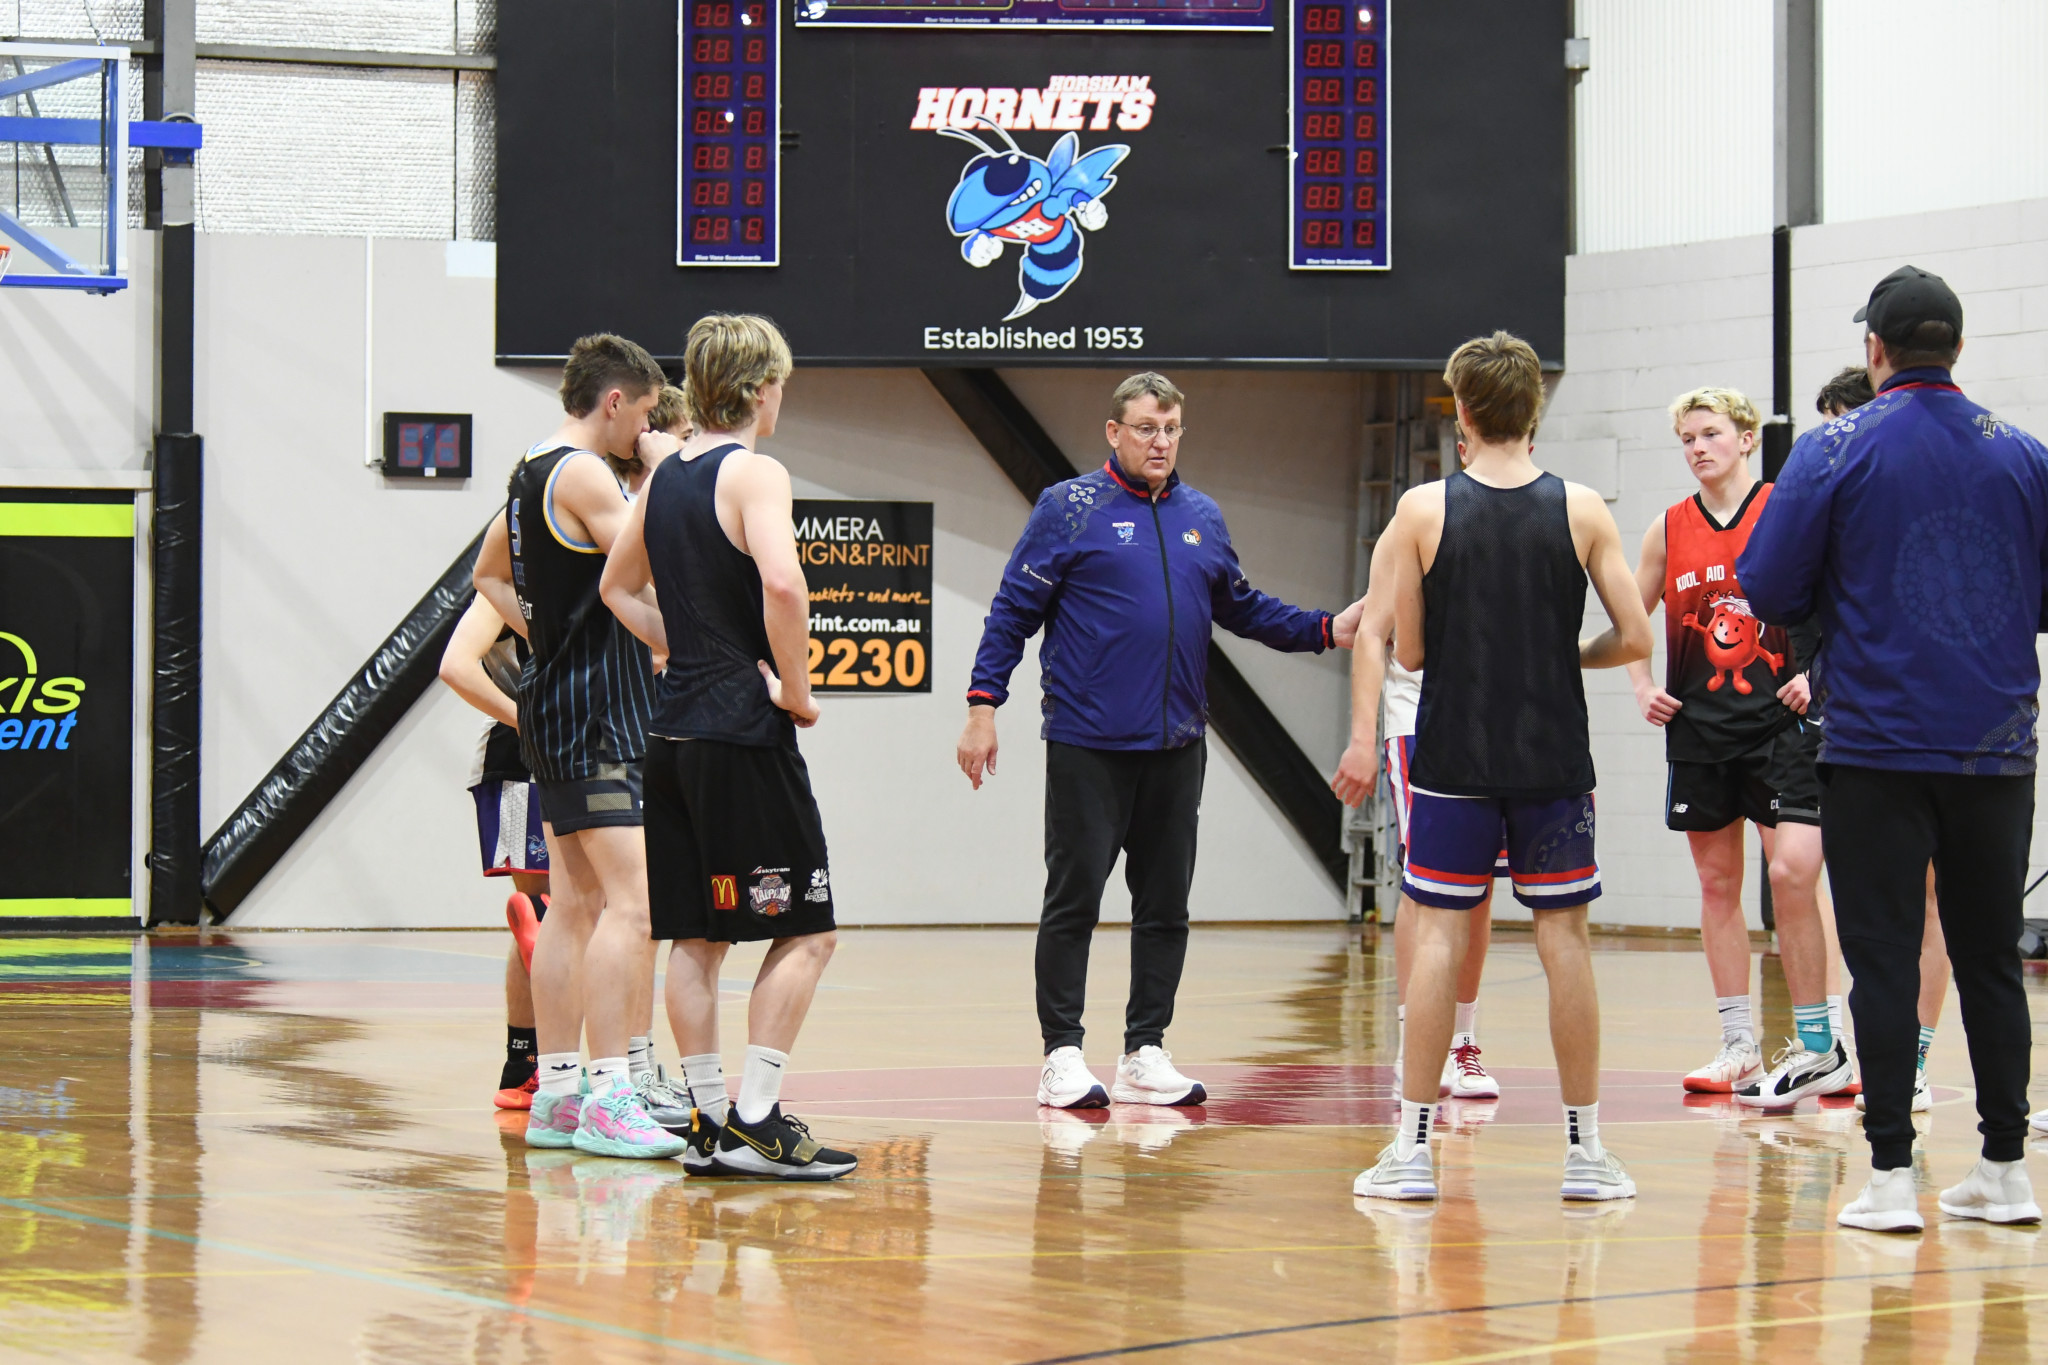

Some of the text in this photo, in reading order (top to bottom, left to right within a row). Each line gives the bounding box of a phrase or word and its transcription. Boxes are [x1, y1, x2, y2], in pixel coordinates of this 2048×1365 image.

[1049, 75, 1150, 92] HORSHAM
[910, 87, 1156, 131] HORNETS
[924, 326, 1144, 349] Established 1953
[1676, 564, 1725, 592] KOOL AID
[867, 588, 890, 604] and
[808, 637, 926, 687] 2230
